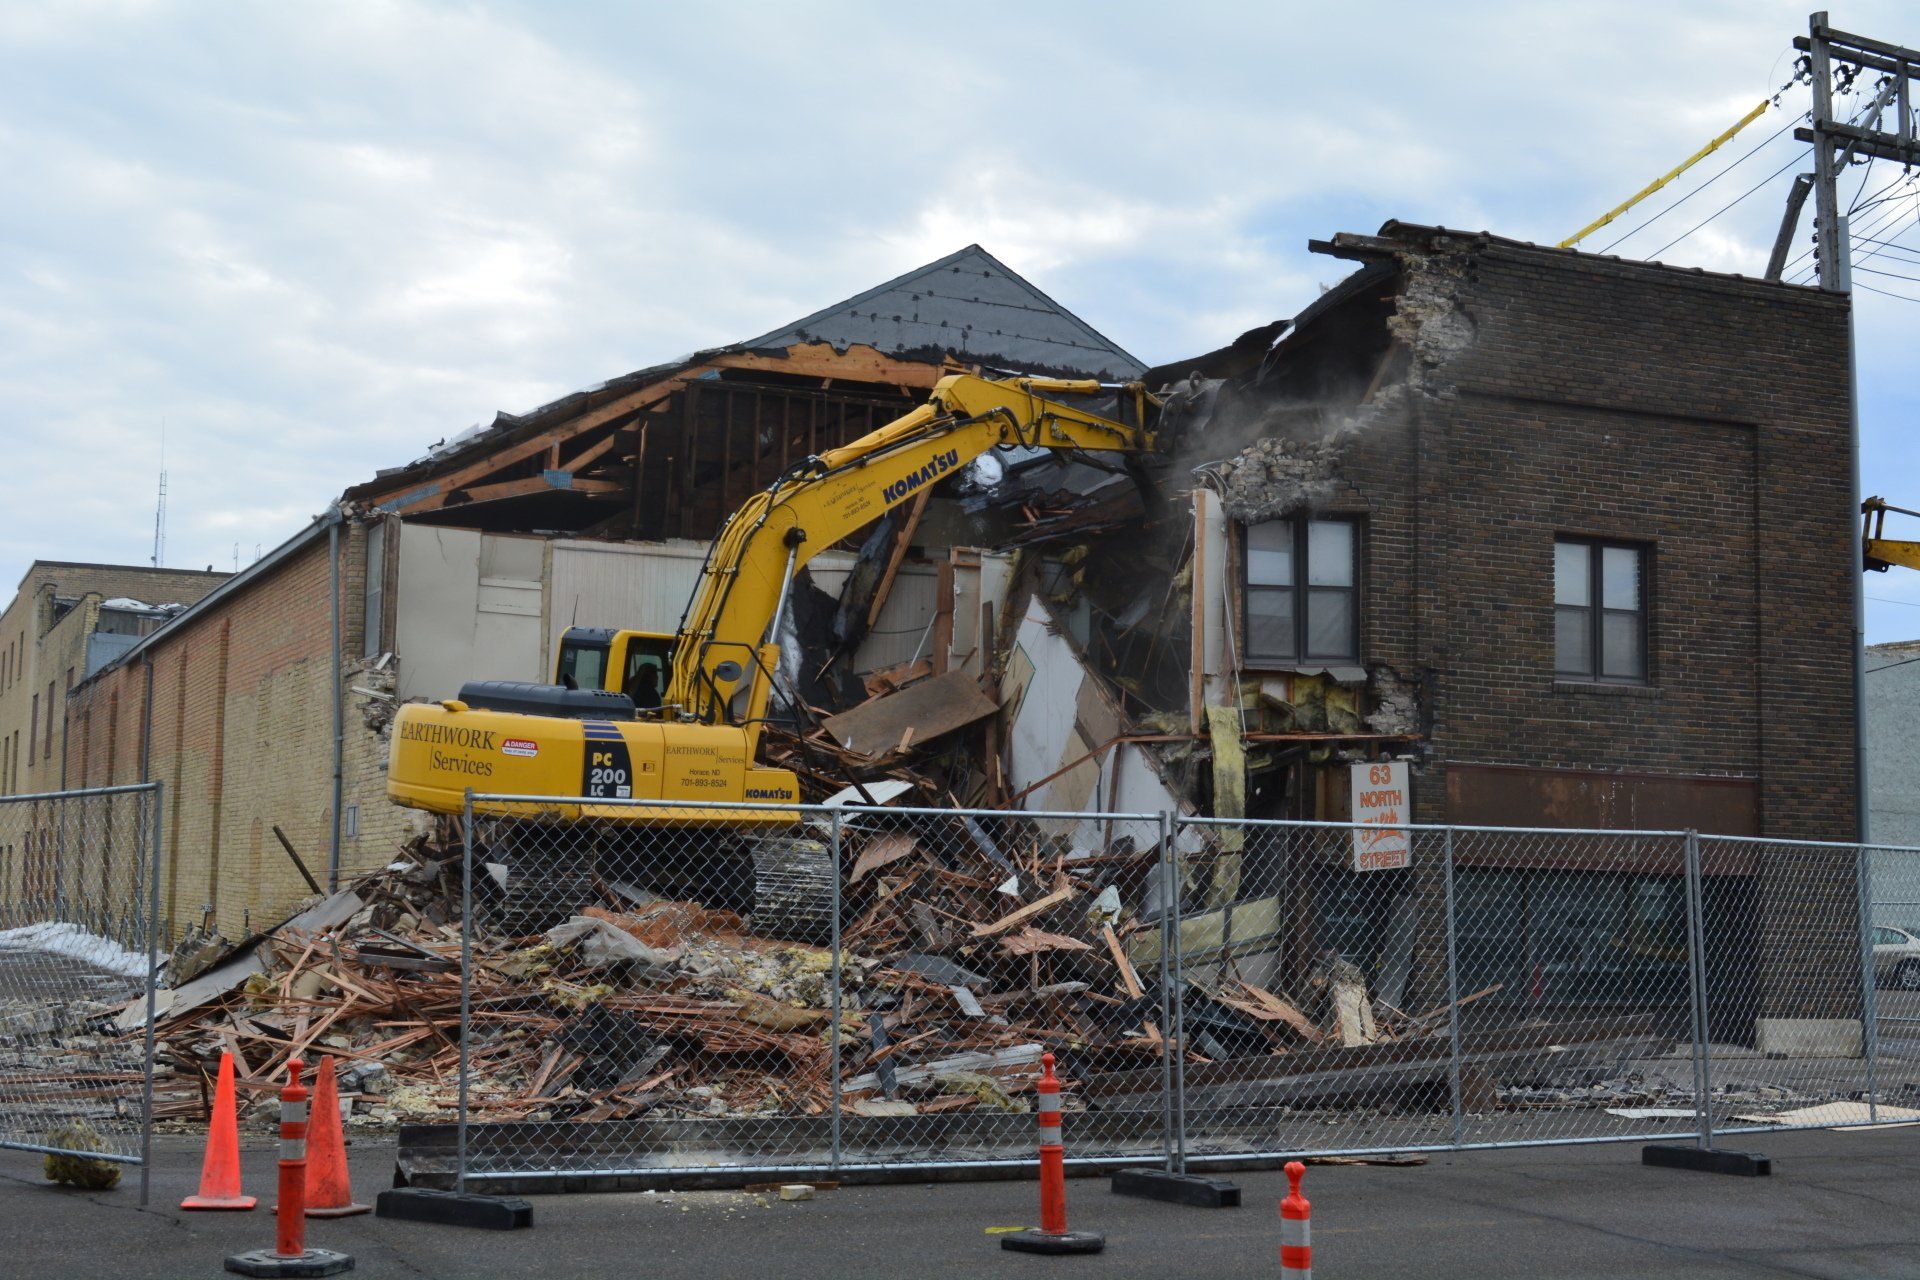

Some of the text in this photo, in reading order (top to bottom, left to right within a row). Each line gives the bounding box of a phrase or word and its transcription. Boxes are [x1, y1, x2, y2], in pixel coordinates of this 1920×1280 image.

[882, 448, 959, 504] KOMATSU
[400, 721, 497, 750] EARTHWORK
[510, 741, 535, 750] DANGER
[666, 746, 716, 756] EARTHWORK
[433, 750, 493, 777] Services
[593, 752, 612, 767] PC
[718, 756, 745, 765] Services
[591, 768, 626, 785] 200
[1369, 765, 1392, 785] 63
[591, 785, 604, 797] LC
[746, 787, 792, 800] KOMATSU
[1360, 790, 1403, 808] NORTH
[1360, 850, 1407, 869] STREET
